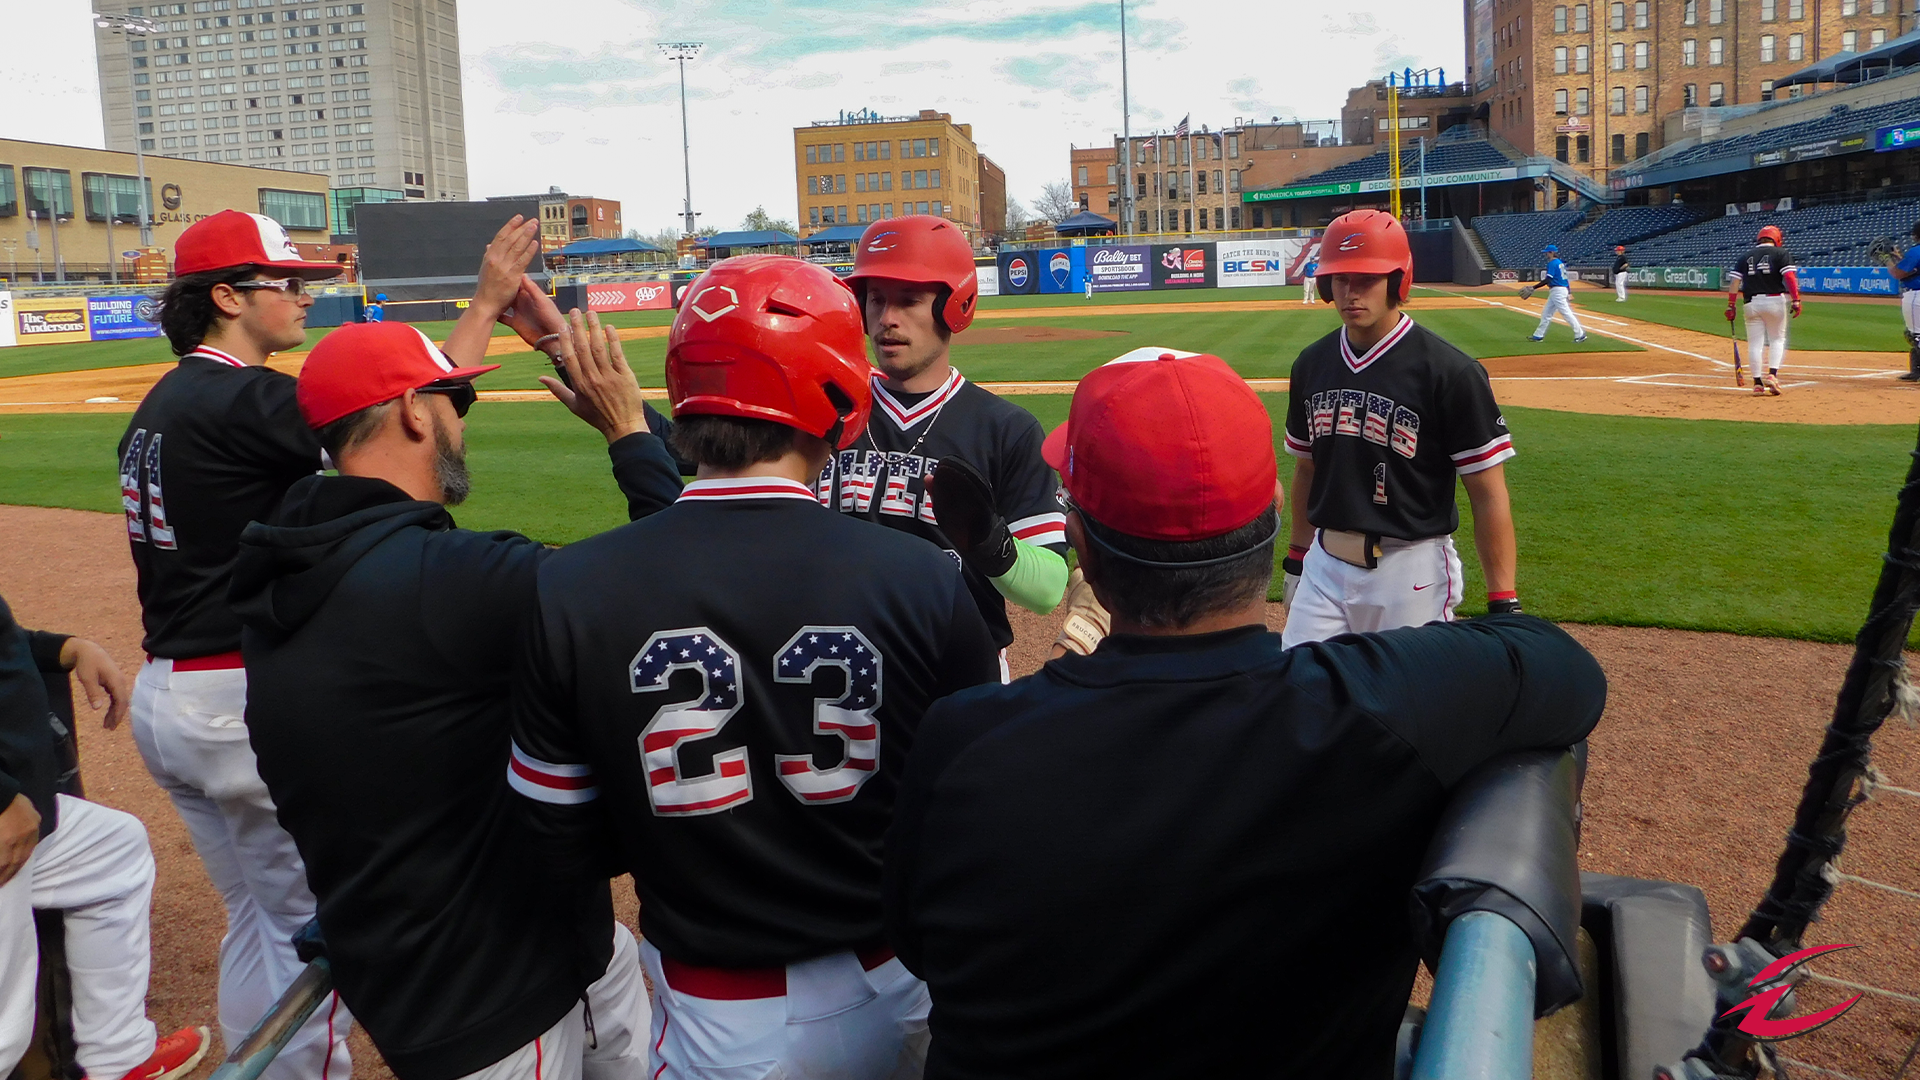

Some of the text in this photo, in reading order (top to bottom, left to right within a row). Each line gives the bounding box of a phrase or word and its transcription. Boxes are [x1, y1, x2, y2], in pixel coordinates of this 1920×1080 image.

[1368, 179, 1412, 190] DEDICAED
[1426, 176, 1444, 185] OUR
[1446, 171, 1503, 184] COMMUNITY.
[160, 212, 191, 223] GLASS
[1093, 249, 1142, 264] Bally BET
[1223, 250, 1241, 260] CATCH
[1255, 249, 1271, 257] HENS
[1100, 265, 1136, 273] SPORTSBOOK
[1223, 259, 1280, 273] BCSN
[1746, 255, 1771, 276] 14
[1627, 268, 1656, 286] reat Clips
[1663, 268, 1708, 288] Great Clips
[1822, 276, 1853, 291] AQUAFINA
[1859, 278, 1892, 292] AQUAFINA
[637, 287, 656, 300] AAA
[90, 300, 132, 310] BUILDING
[20, 312, 44, 323] The
[94, 314, 133, 324] FUTURE
[23, 321, 85, 333] Andersons
[1304, 388, 1421, 460] OWENS
[1373, 462, 1388, 505] 1
[628, 625, 883, 817] 23
